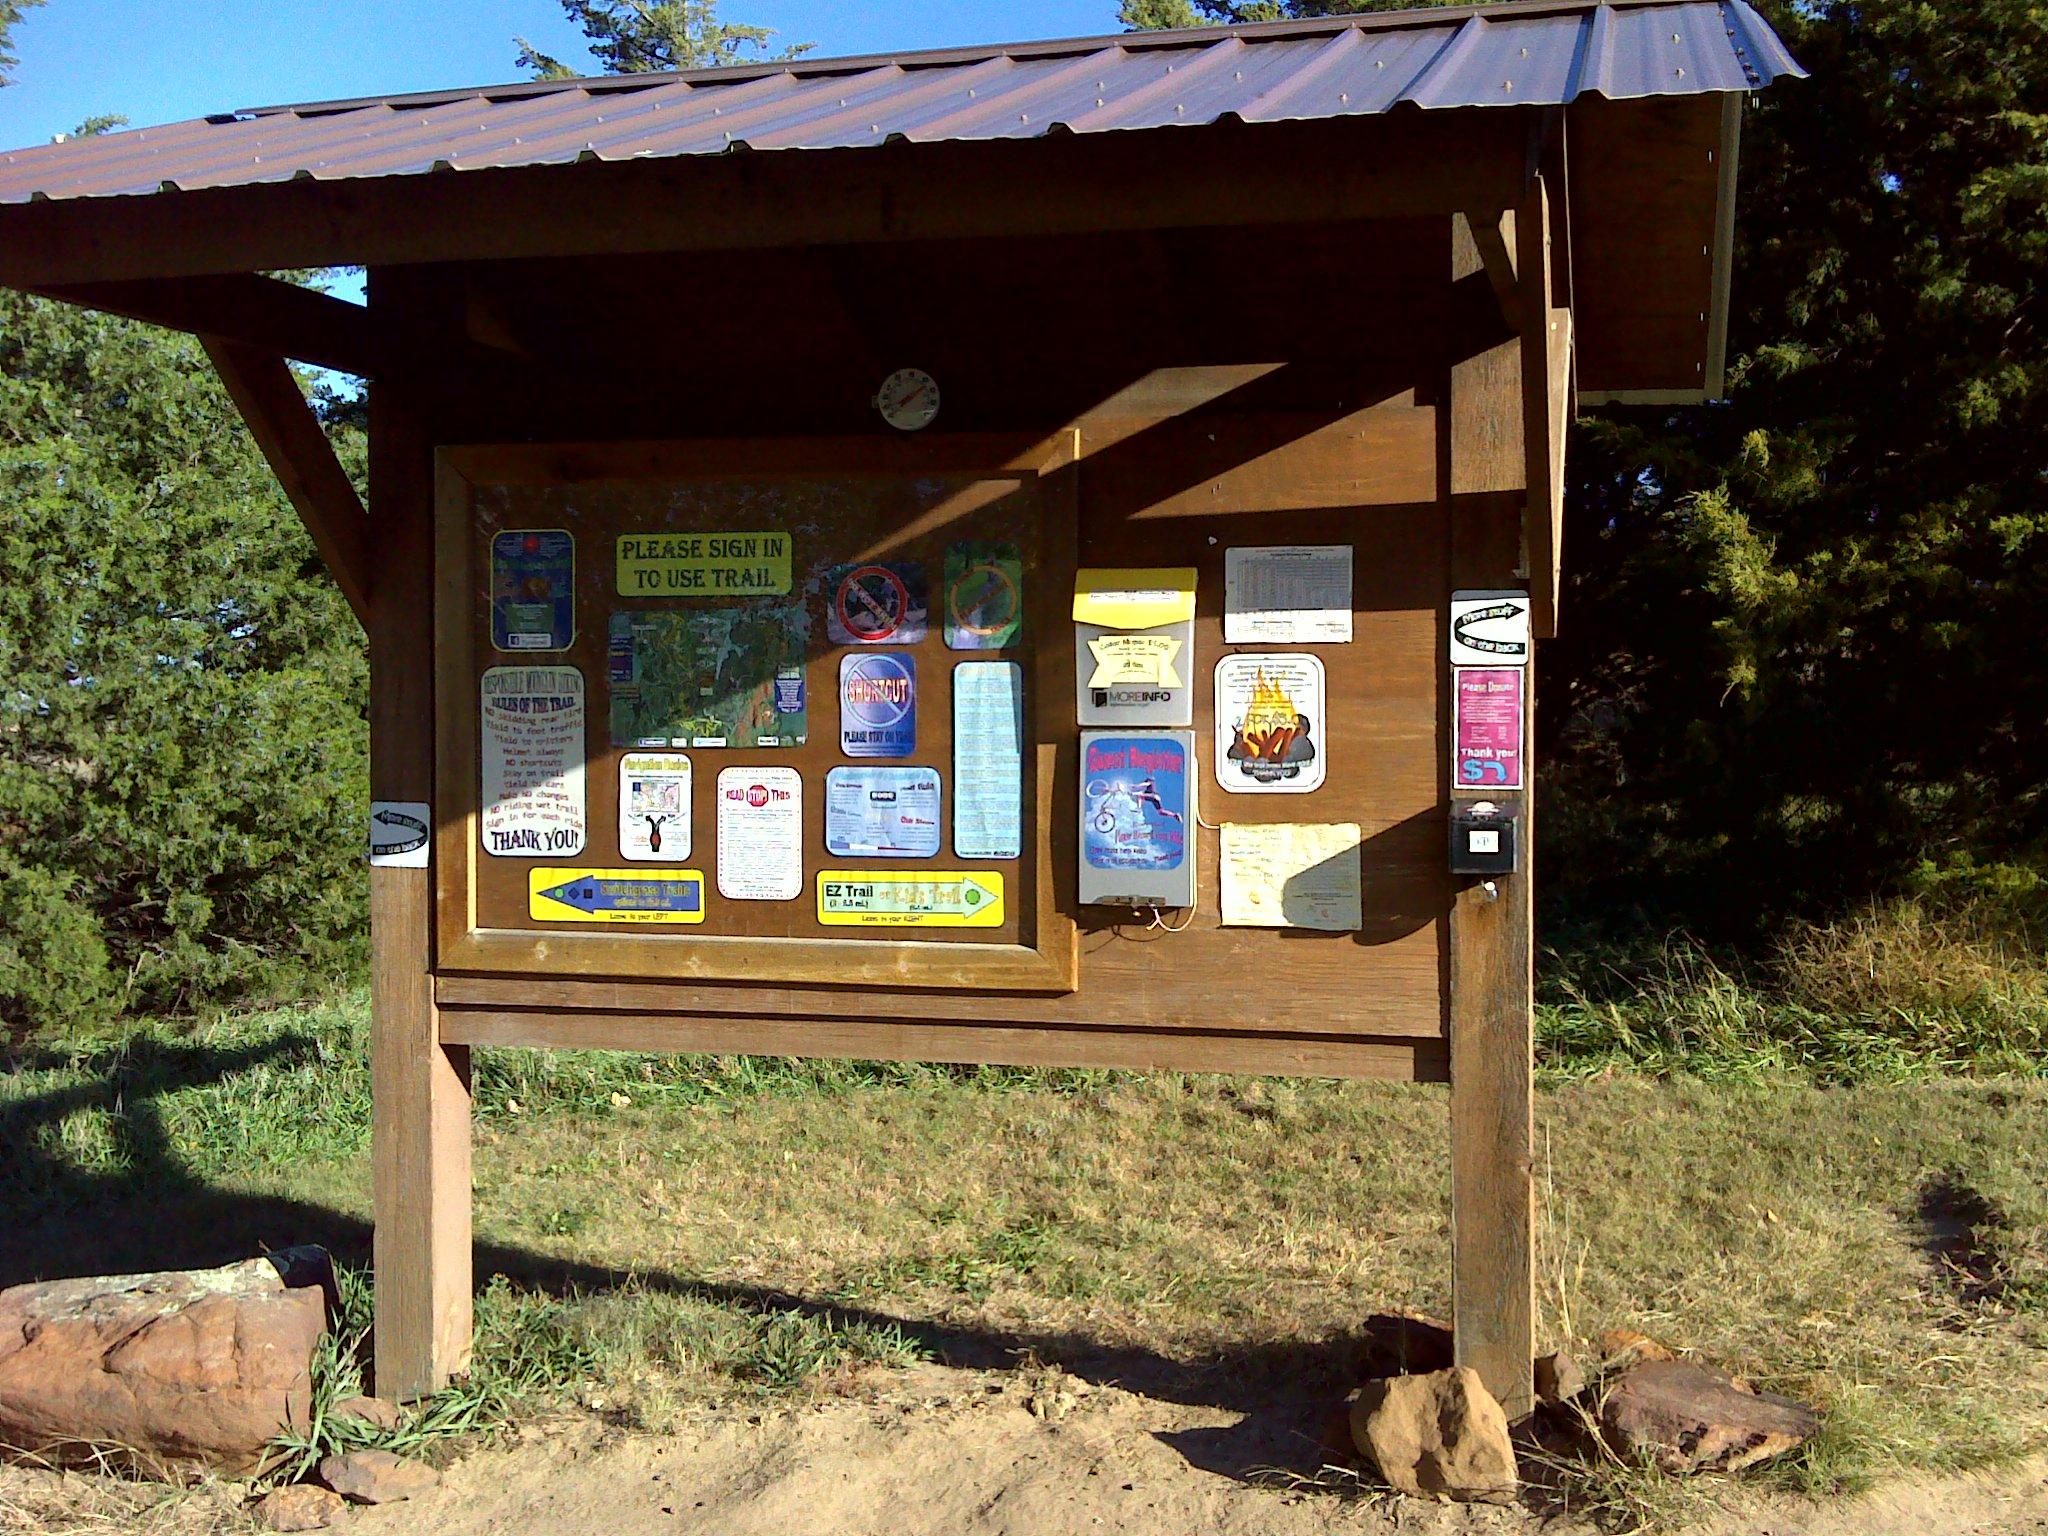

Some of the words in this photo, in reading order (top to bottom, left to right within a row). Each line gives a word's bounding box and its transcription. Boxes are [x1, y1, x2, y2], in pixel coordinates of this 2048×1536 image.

[622, 539, 702, 559] PLEASE
[708, 538, 757, 558] SIGN
[763, 538, 783, 558] IN
[635, 569, 662, 589] TO
[667, 568, 705, 588] USE
[711, 567, 776, 588] TRAIL
[849, 678, 908, 704] SHORTCUT
[1110, 691, 1171, 702] MOREINFO
[492, 697, 518, 712] RULES
[519, 697, 530, 713] OF
[532, 697, 548, 713] THE
[550, 697, 575, 711] TRAIL
[844, 731, 867, 743] PLEASE
[1460, 748, 1493, 758] Thank
[490, 829, 542, 851] THANK
[544, 827, 578, 851] YOU!
[826, 885, 841, 897] EZ
[846, 884, 873, 898] Trail
